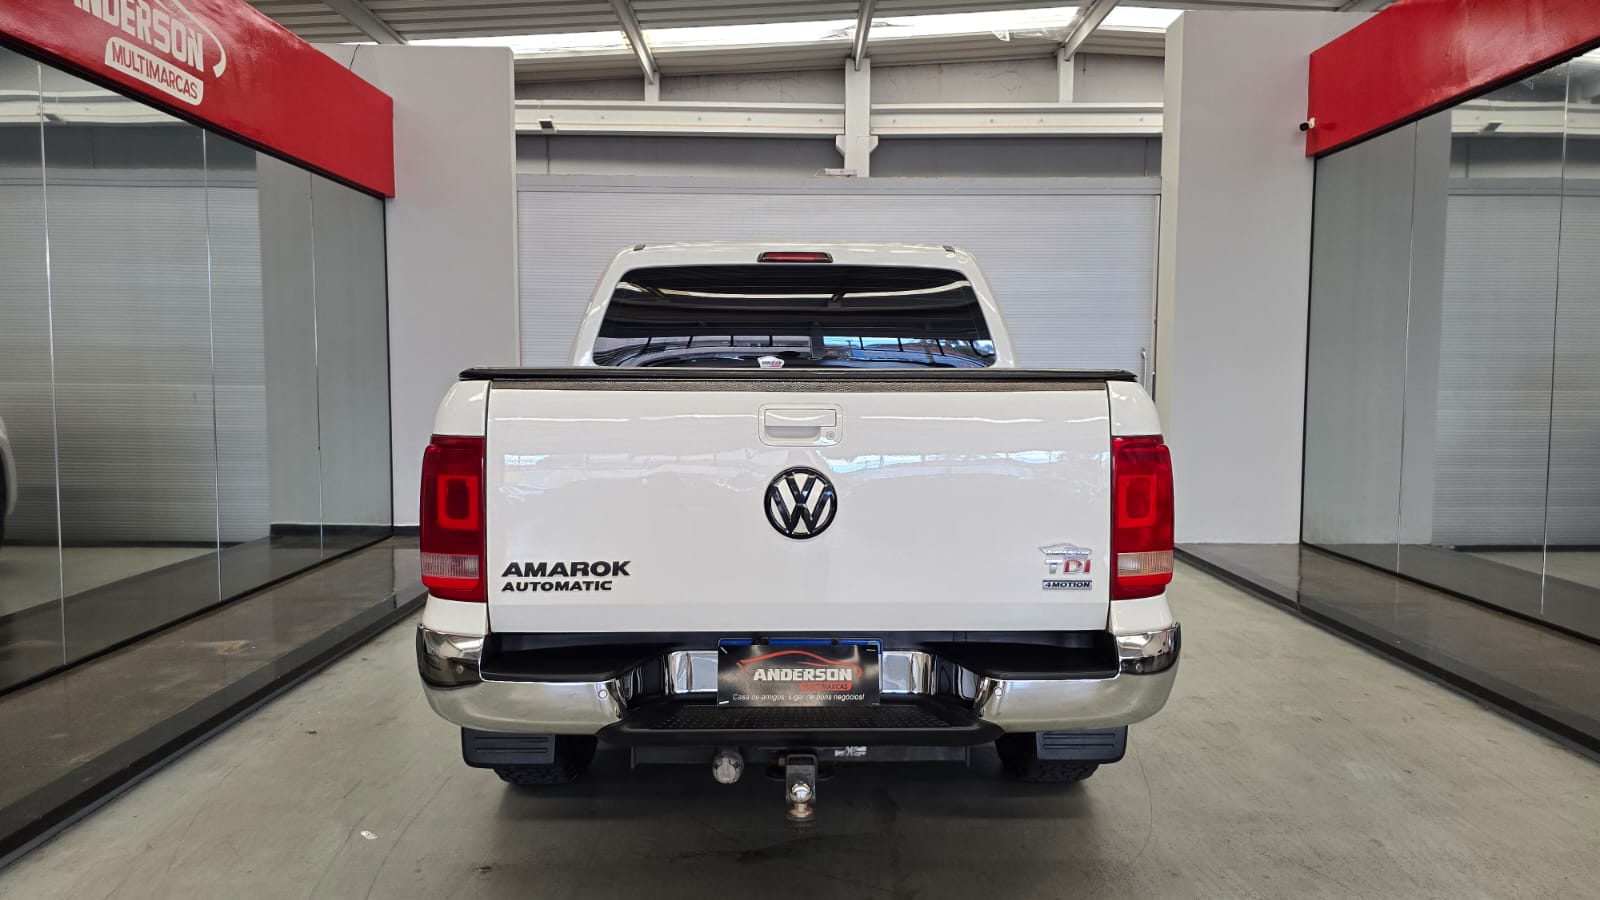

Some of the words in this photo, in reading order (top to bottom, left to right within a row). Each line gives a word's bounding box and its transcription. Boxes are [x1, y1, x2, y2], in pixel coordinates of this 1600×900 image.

[74, 0, 204, 72] DERSON
[111, 41, 198, 100] MULTIMARCAS
[501, 561, 631, 577] AMAROK
[1045, 559, 1091, 574] TDI
[501, 581, 612, 592] AUTOMATIC
[753, 668, 852, 681] ANDERSON
